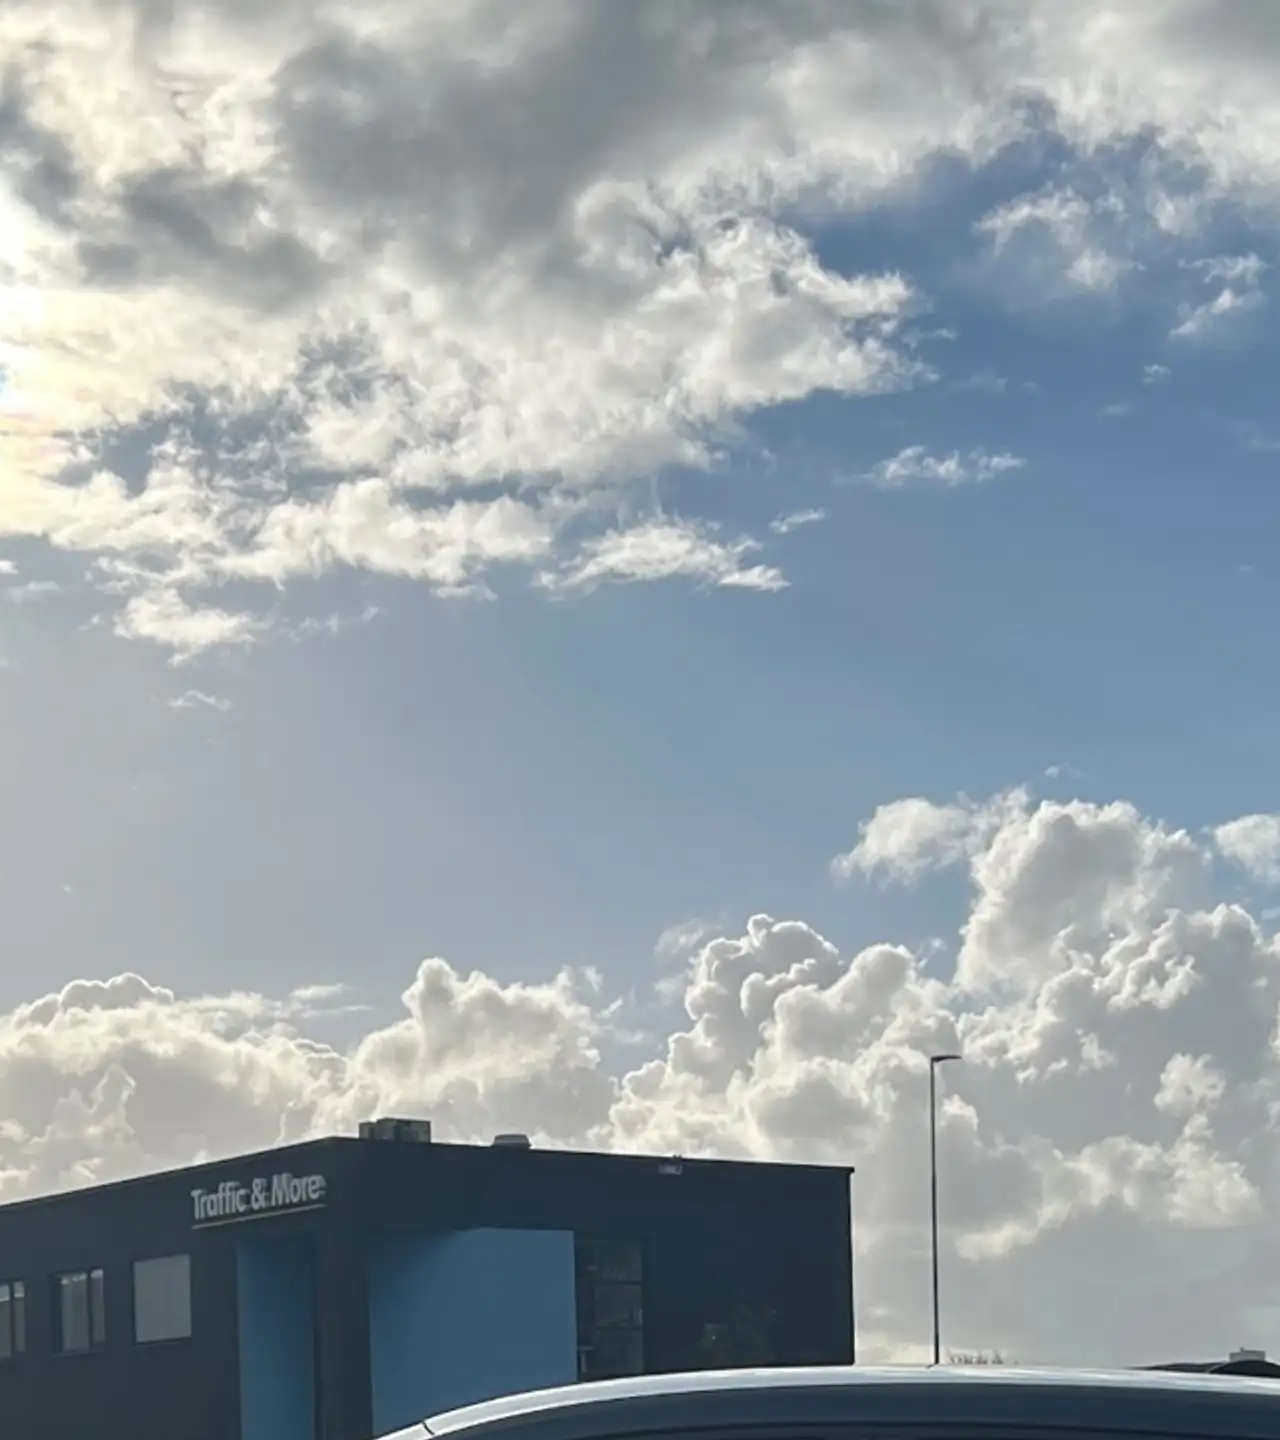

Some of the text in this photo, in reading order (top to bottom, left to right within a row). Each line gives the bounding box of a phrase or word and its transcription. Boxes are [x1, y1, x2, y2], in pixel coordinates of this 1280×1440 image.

[190, 1172, 326, 1219] Traffic & More
